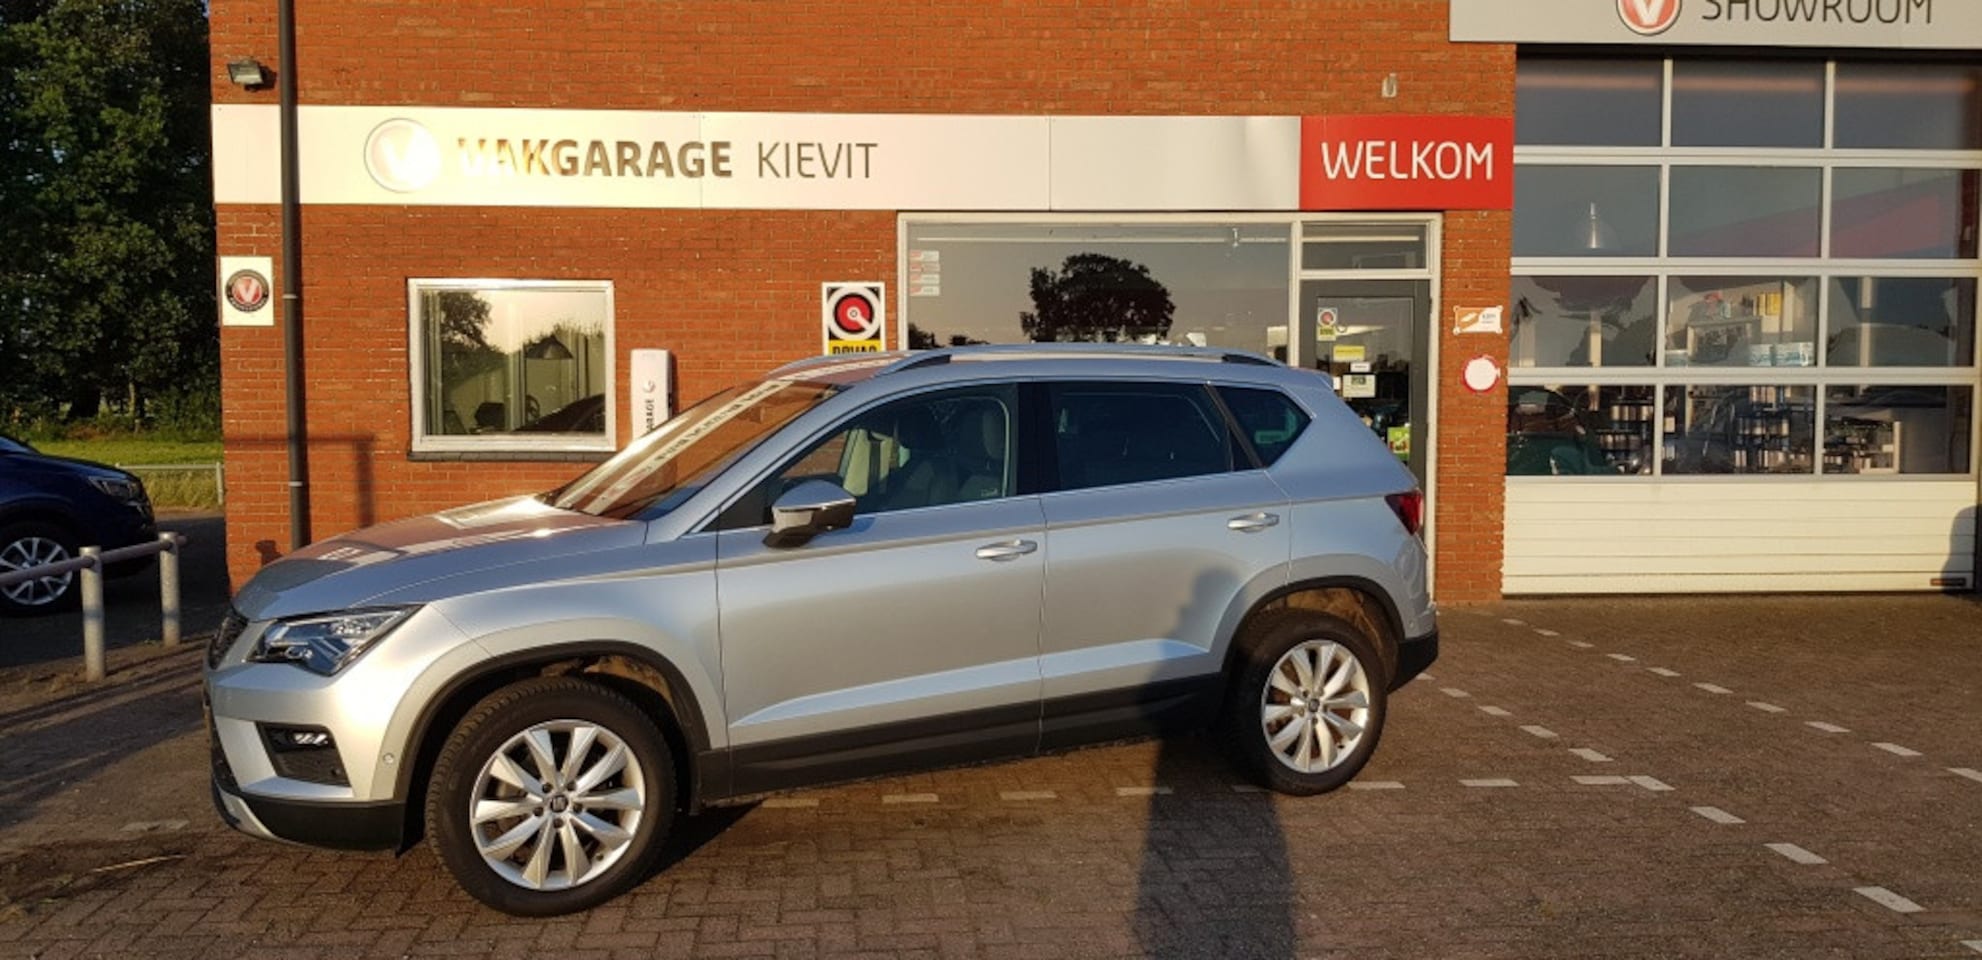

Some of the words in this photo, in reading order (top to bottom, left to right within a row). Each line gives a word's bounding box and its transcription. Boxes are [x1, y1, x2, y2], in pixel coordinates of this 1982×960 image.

[1702, 0, 1932, 23] SHOWROOM
[758, 142, 878, 178] KIEVIT
[1321, 141, 1493, 181] WELKOM
